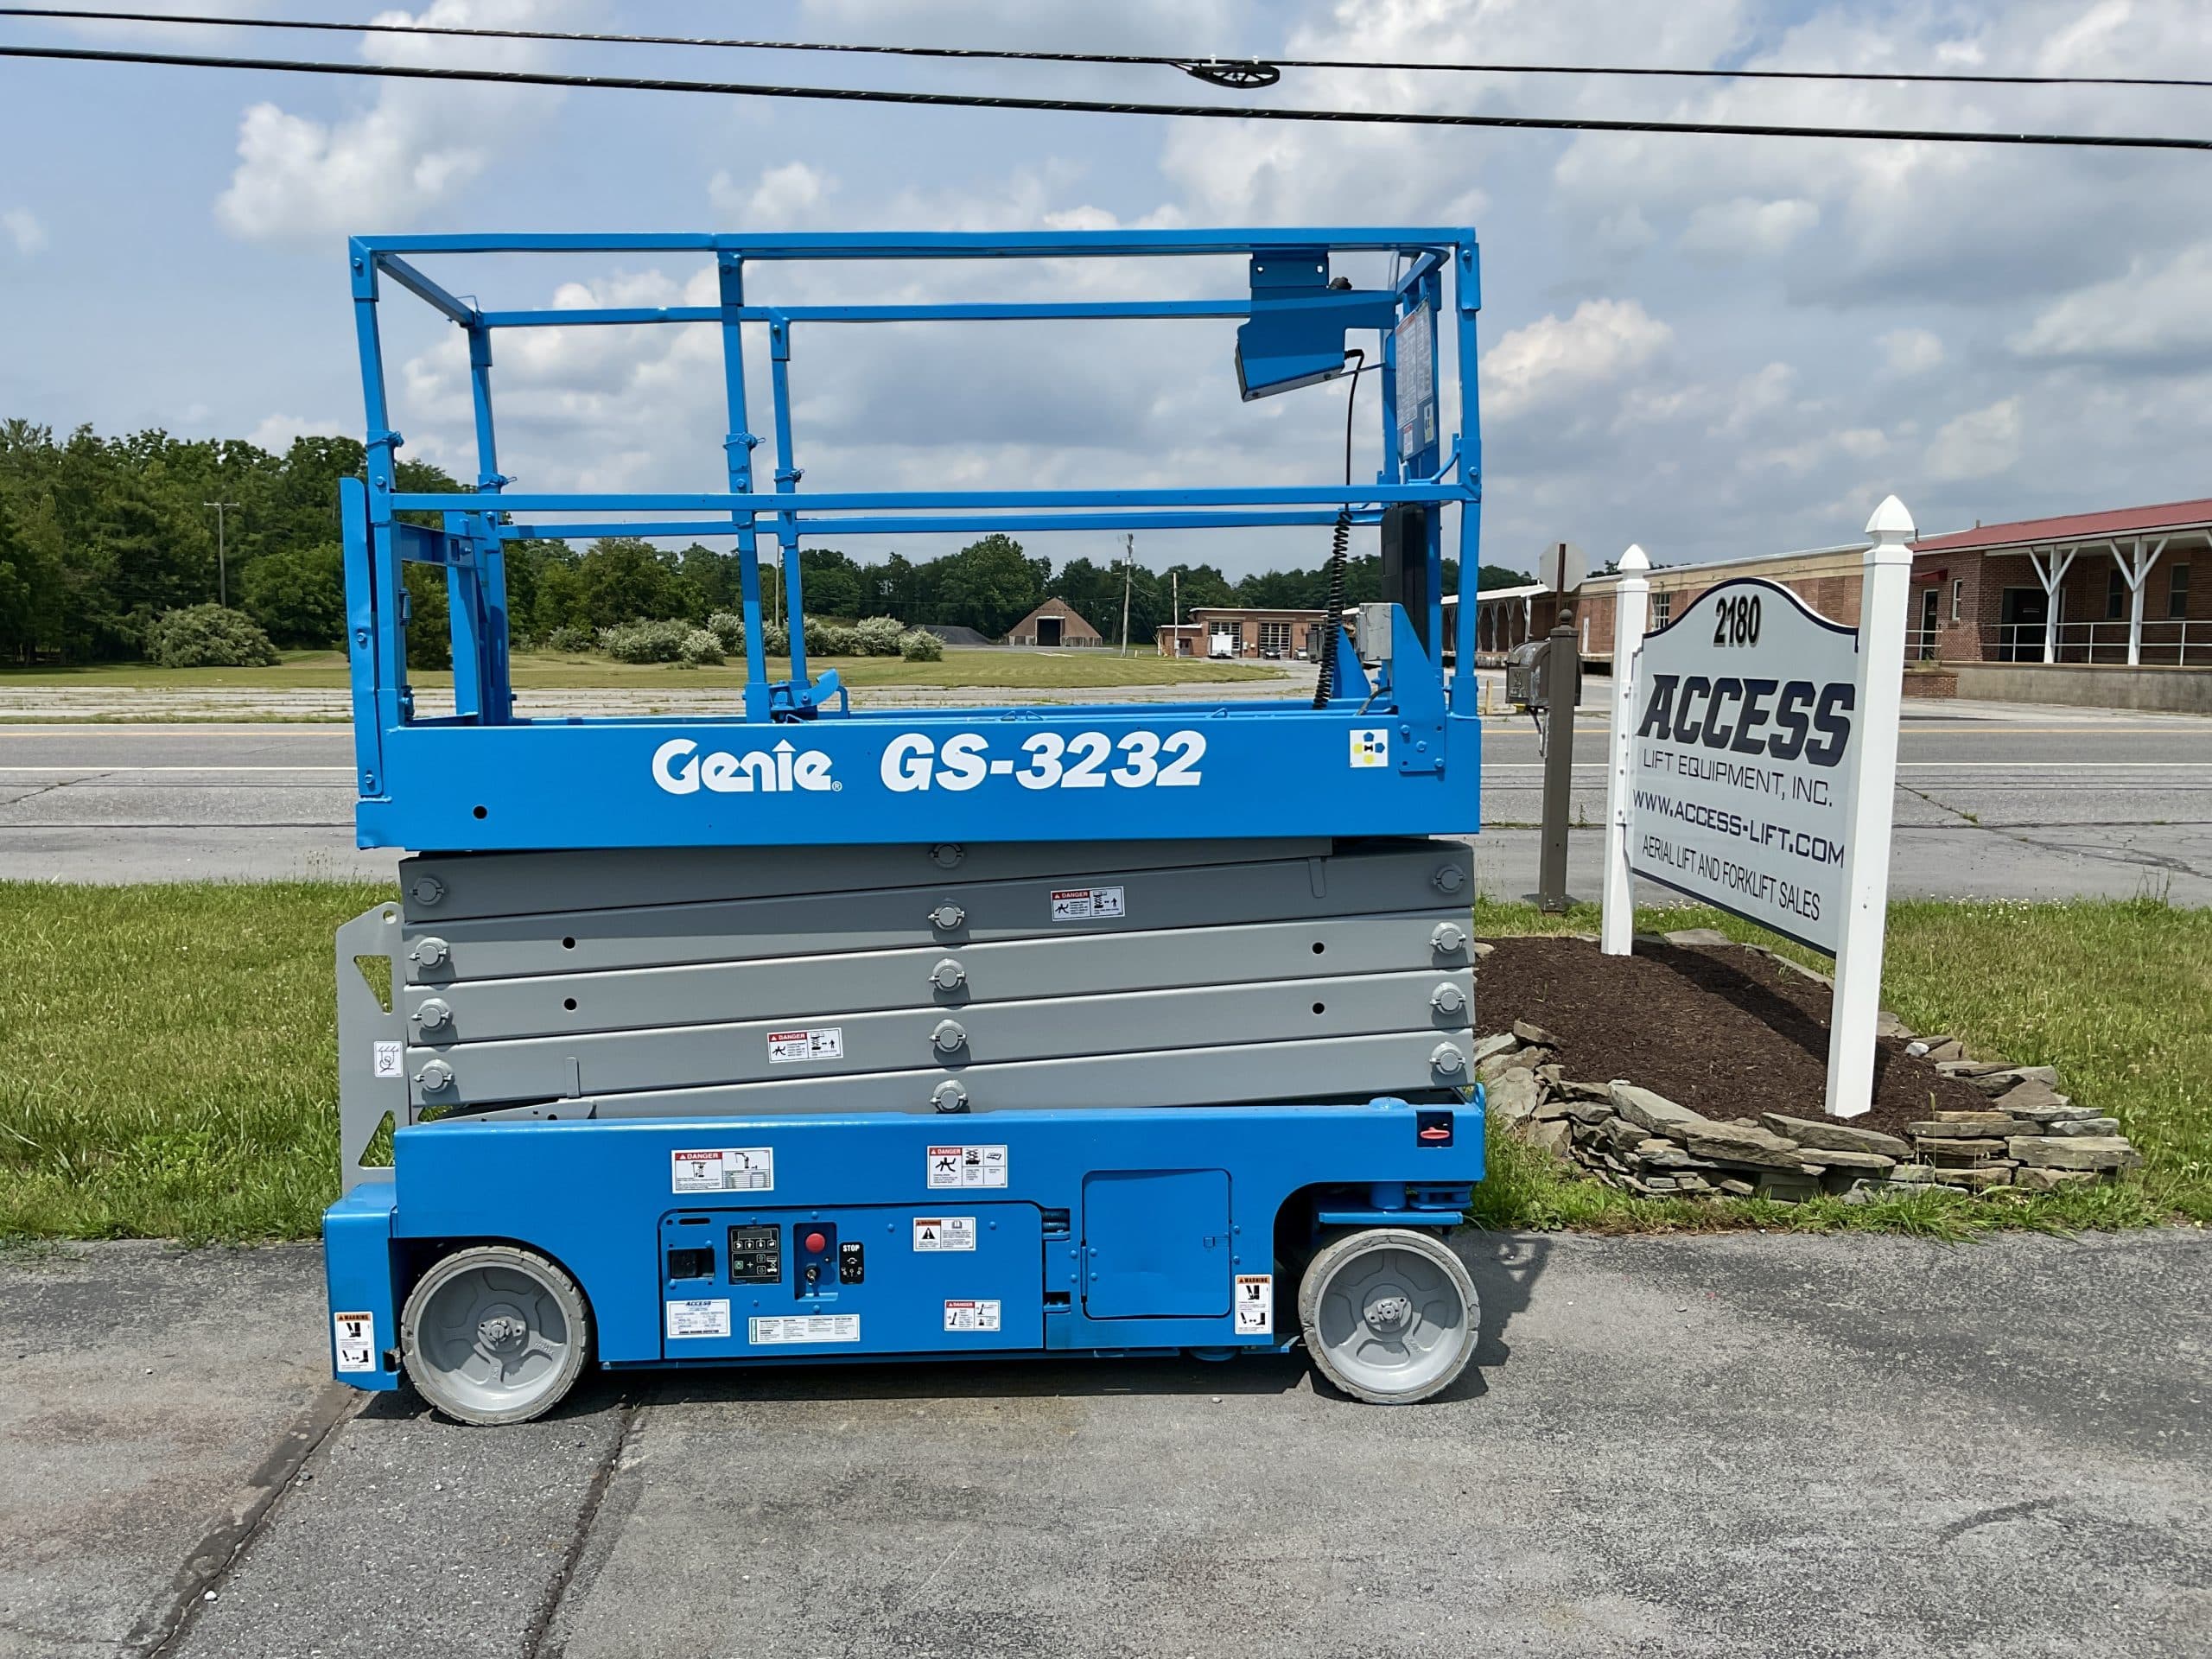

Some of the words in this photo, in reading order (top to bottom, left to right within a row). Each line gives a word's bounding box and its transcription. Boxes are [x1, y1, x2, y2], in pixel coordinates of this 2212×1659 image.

[1713, 594, 1760, 646] 2180
[1637, 674, 1855, 766] ACCESS
[880, 730, 1207, 792] GS-3232
[1643, 748, 1674, 772] LIFT
[1678, 755, 1785, 801] EQUIPMENT,
[1792, 775, 1833, 807] INC.
[1632, 788, 1845, 868] WWW.ACCESS-LIFT.COM
[1643, 835, 1675, 866] AERIAL
[1677, 845, 1696, 875] LIFT
[1698, 853, 1719, 881] AND
[1723, 861, 1777, 903] FORKLIFT
[1779, 881, 1821, 921] SALES
